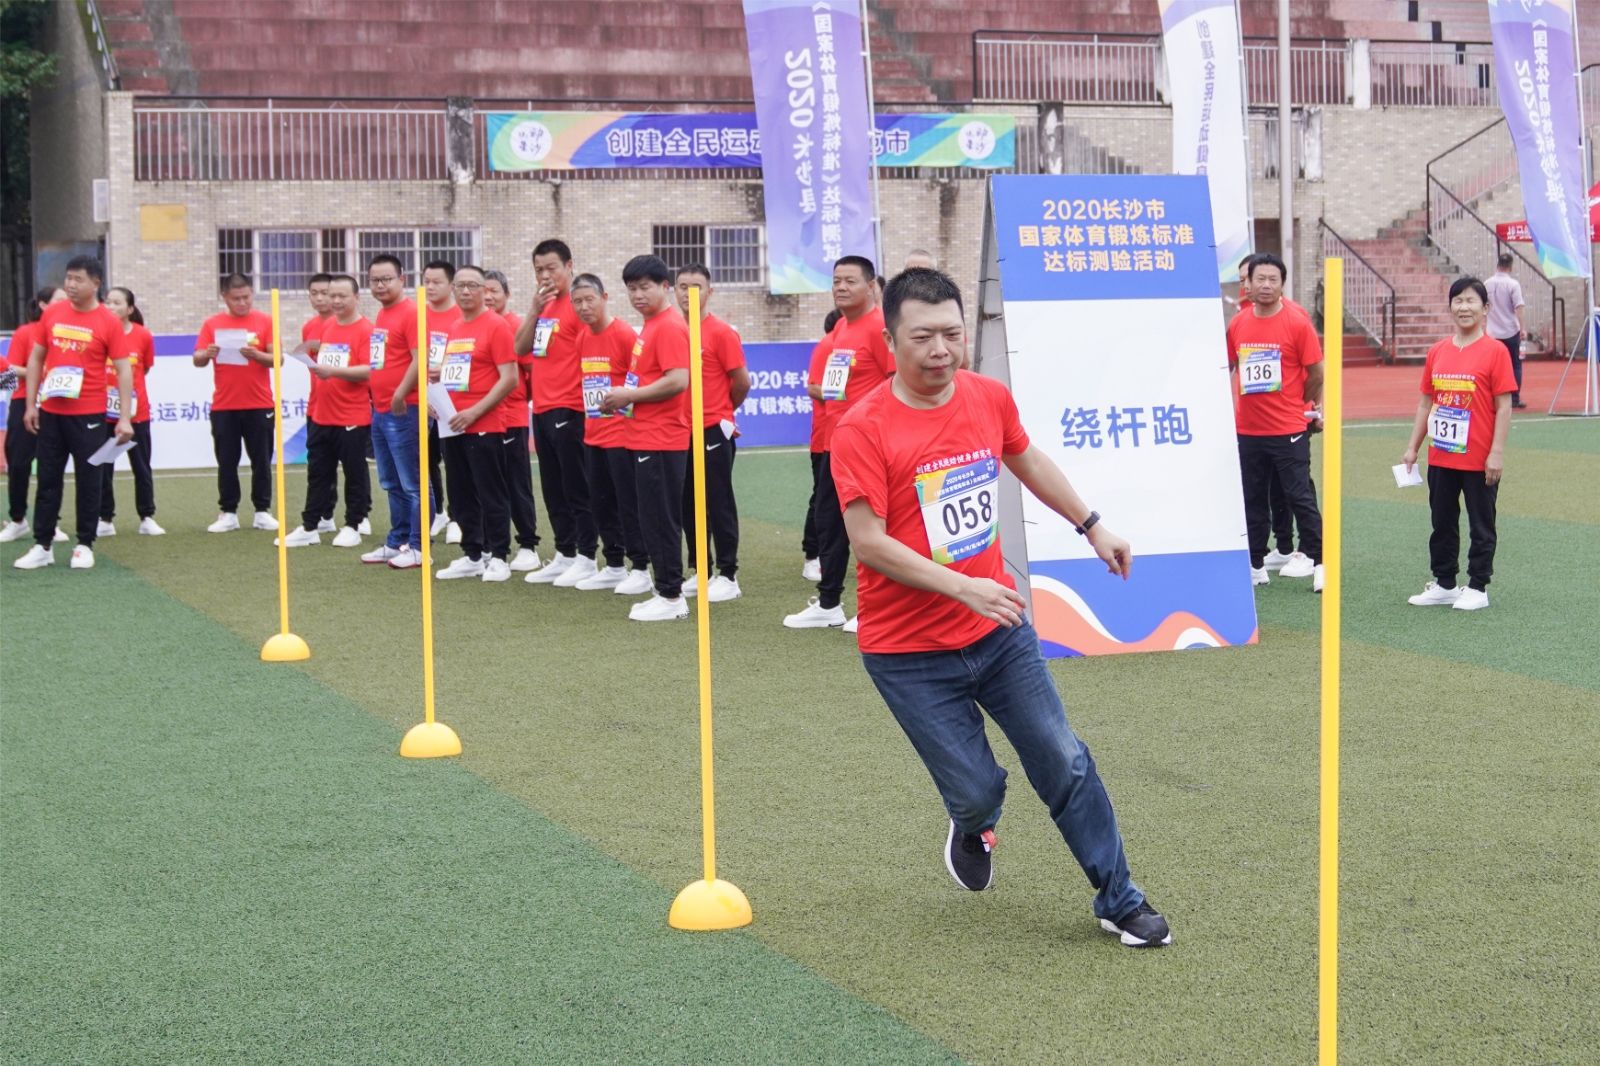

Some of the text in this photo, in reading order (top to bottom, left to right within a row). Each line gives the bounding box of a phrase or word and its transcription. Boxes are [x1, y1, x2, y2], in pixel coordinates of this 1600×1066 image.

[1042, 199, 1166, 221] 2020长沙市
[1018, 224, 1195, 247] 国家体育锻炼标准
[1043, 249, 1175, 273] 达标测验活动
[48, 376, 73, 389] 092
[444, 366, 462, 380] 102
[828, 369, 842, 387] 103
[1246, 364, 1272, 381] 136
[1061, 403, 1193, 449] 绕杆跑
[1434, 420, 1457, 439] 131
[942, 490, 992, 536] 058
